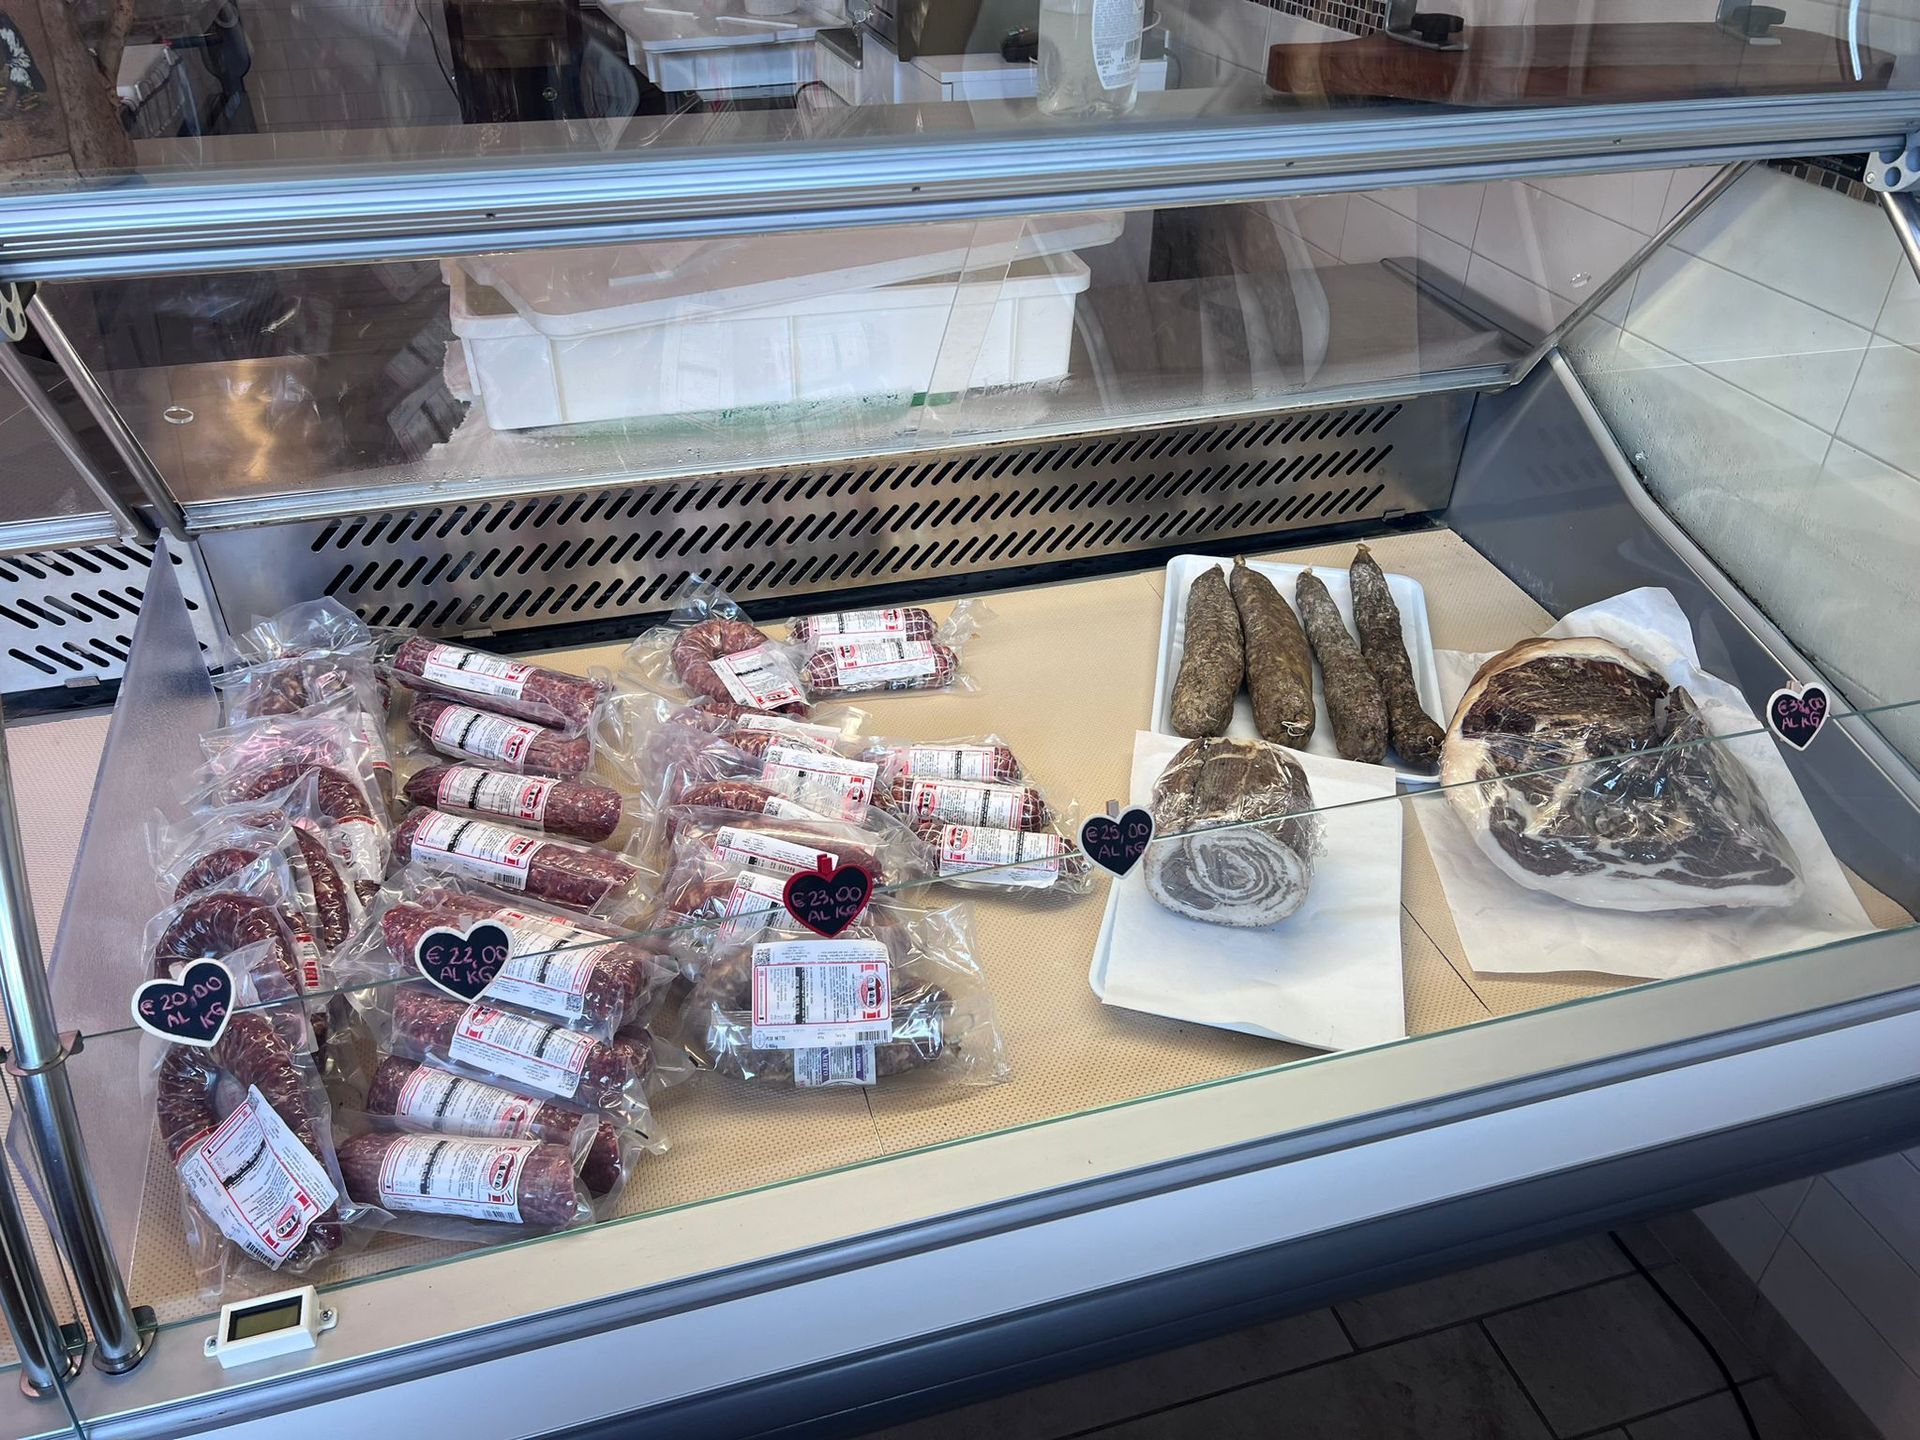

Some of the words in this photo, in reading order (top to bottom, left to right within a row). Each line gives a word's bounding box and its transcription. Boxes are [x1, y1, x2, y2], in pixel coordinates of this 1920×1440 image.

[1782, 717, 1799, 730] AL
[1801, 710, 1820, 728] KG
[1097, 844, 1120, 860] AL
[1125, 841, 1146, 858] KG
[808, 910, 831, 922] AL
[835, 904, 858, 919] KG
[440, 966, 461, 982] AL
[466, 965, 496, 985] KG
[167, 1011, 190, 1028] AL
[200, 1002, 226, 1029] KG
